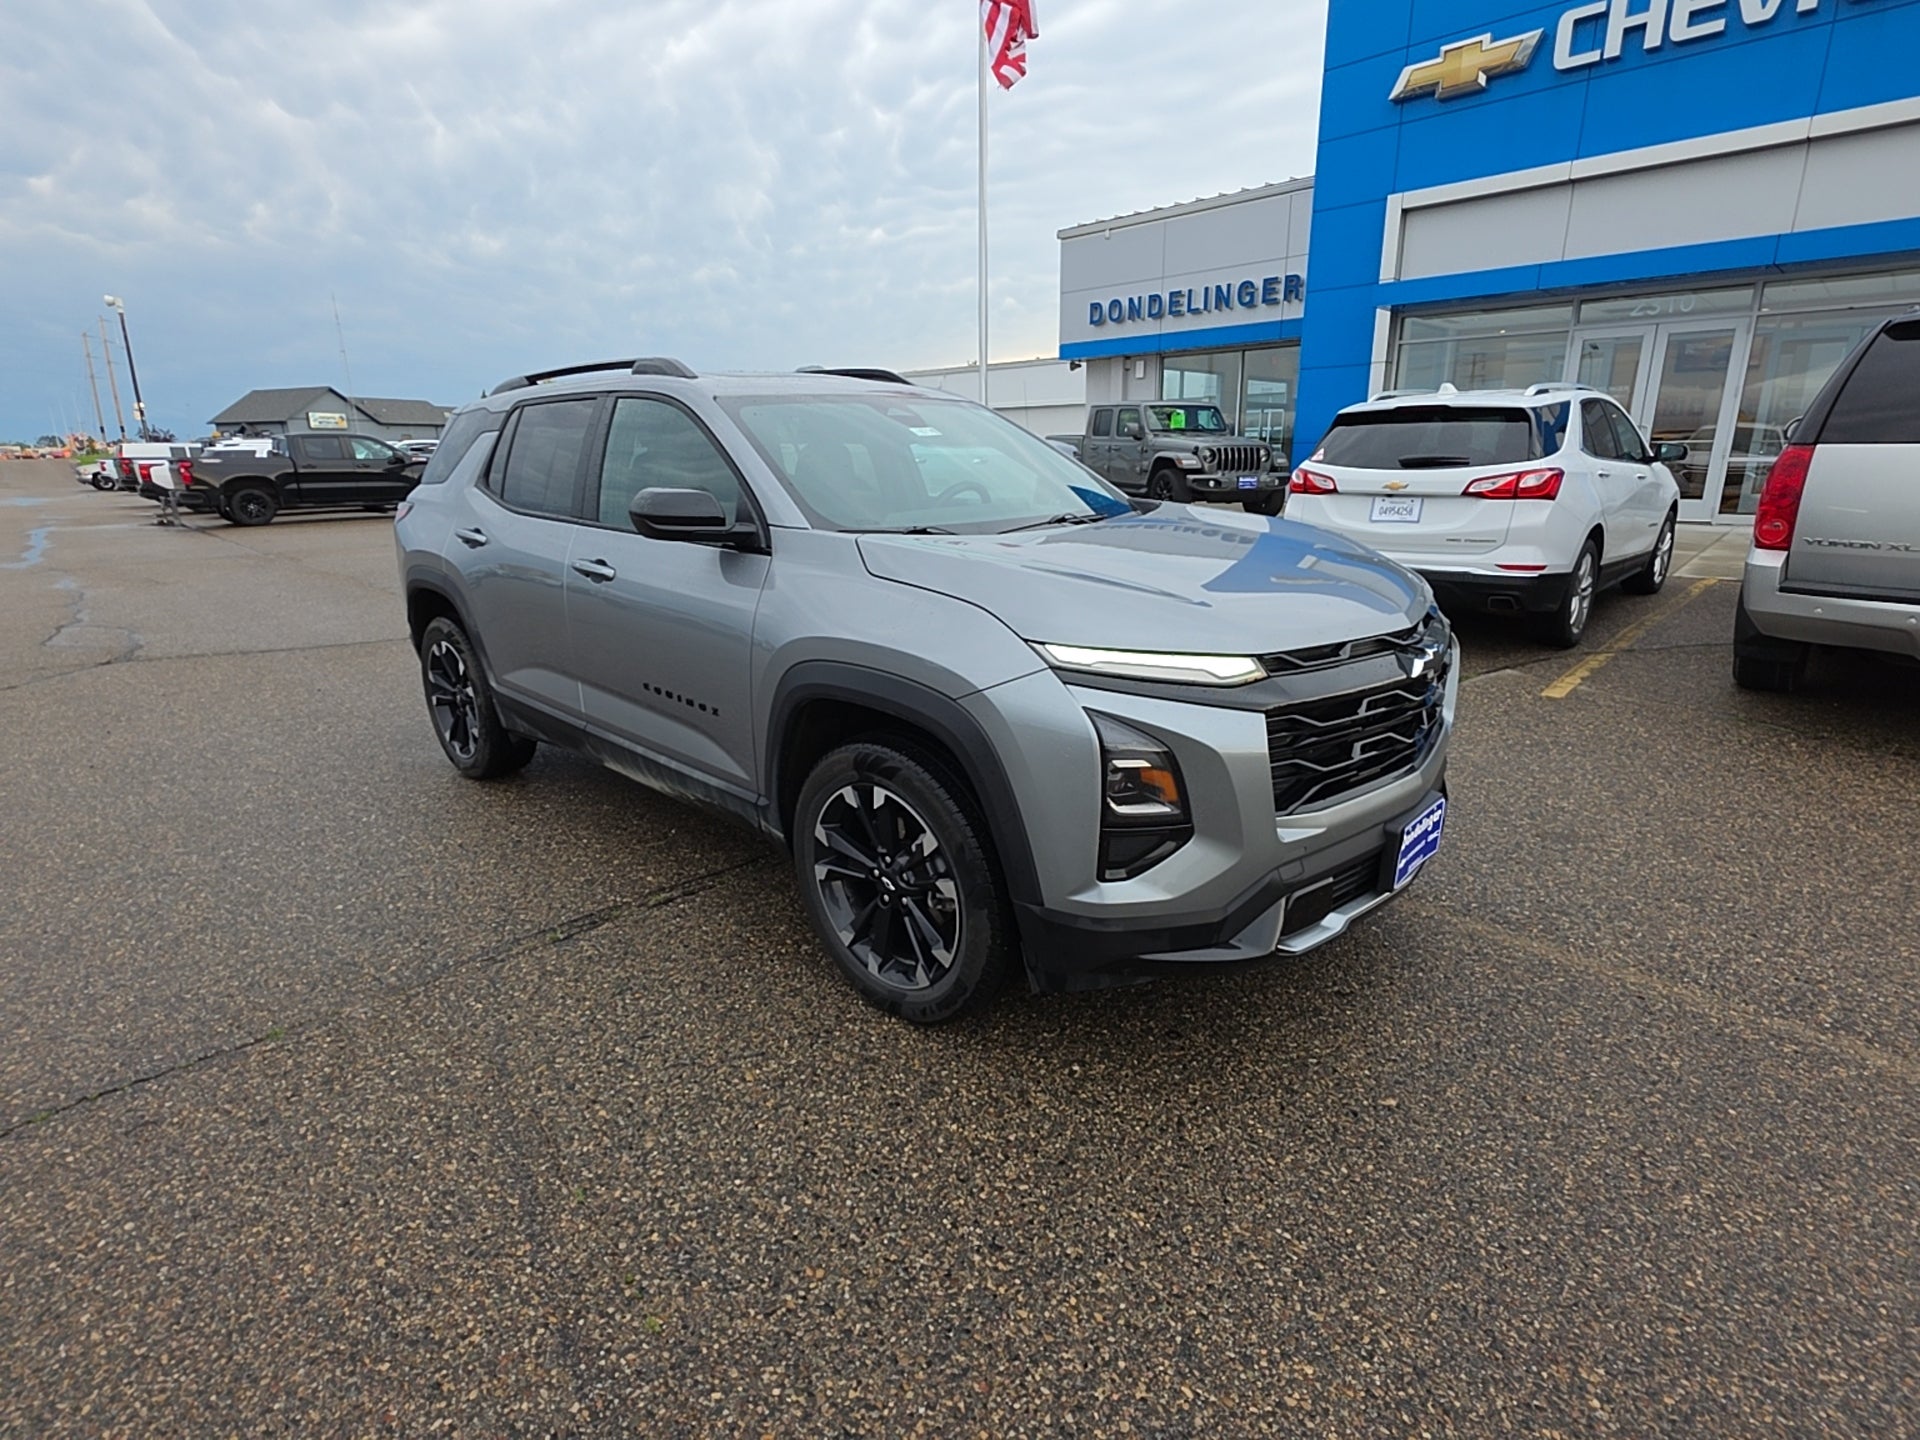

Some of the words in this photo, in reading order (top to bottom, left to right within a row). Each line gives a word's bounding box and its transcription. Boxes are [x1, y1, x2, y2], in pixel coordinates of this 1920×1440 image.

[1553, 0, 1820, 70] CHEV
[1089, 274, 1304, 326] DONDELINGER
[1803, 536, 1881, 550] YUKON
[1886, 541, 1920, 552] XL
